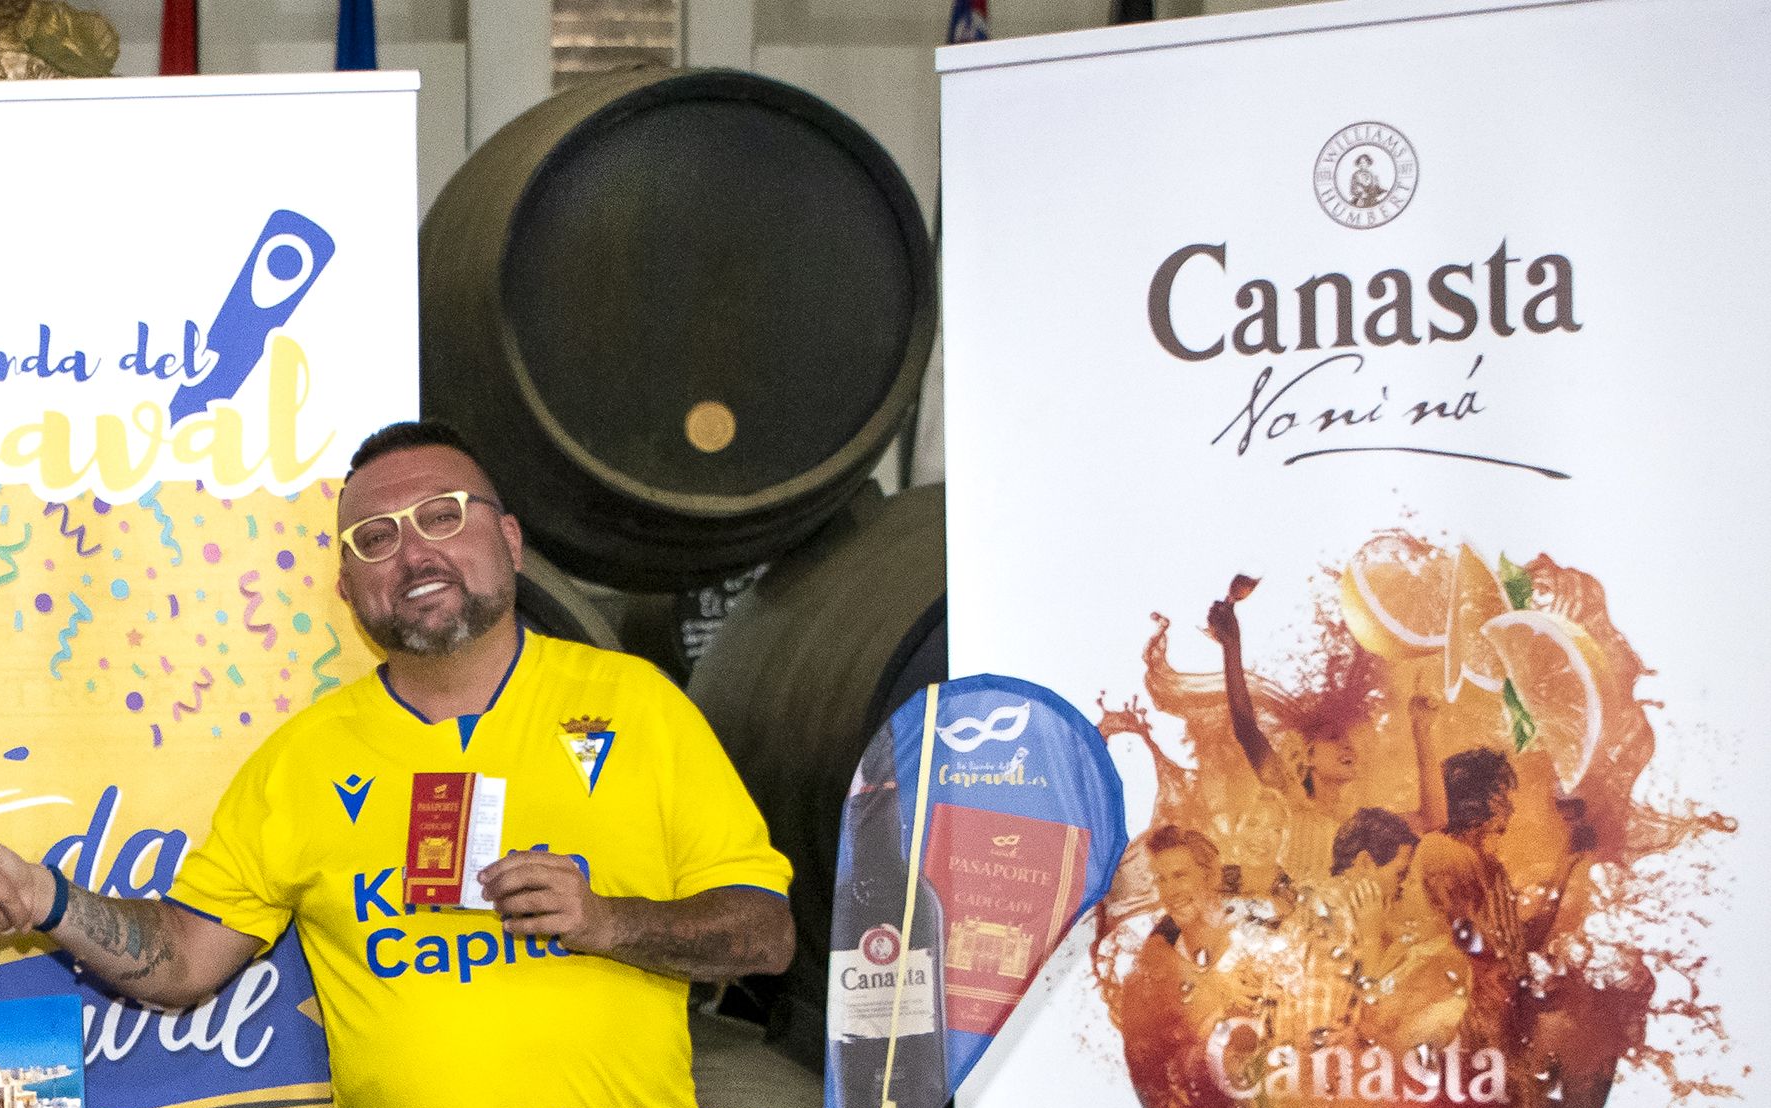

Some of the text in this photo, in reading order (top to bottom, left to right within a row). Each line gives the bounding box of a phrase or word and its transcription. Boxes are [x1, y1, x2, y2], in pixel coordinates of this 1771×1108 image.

[1147, 235, 1583, 362] Canasta
[119, 319, 219, 382] del
[840, 966, 926, 990] Canata
[1206, 1015, 1512, 1103] Canasta
